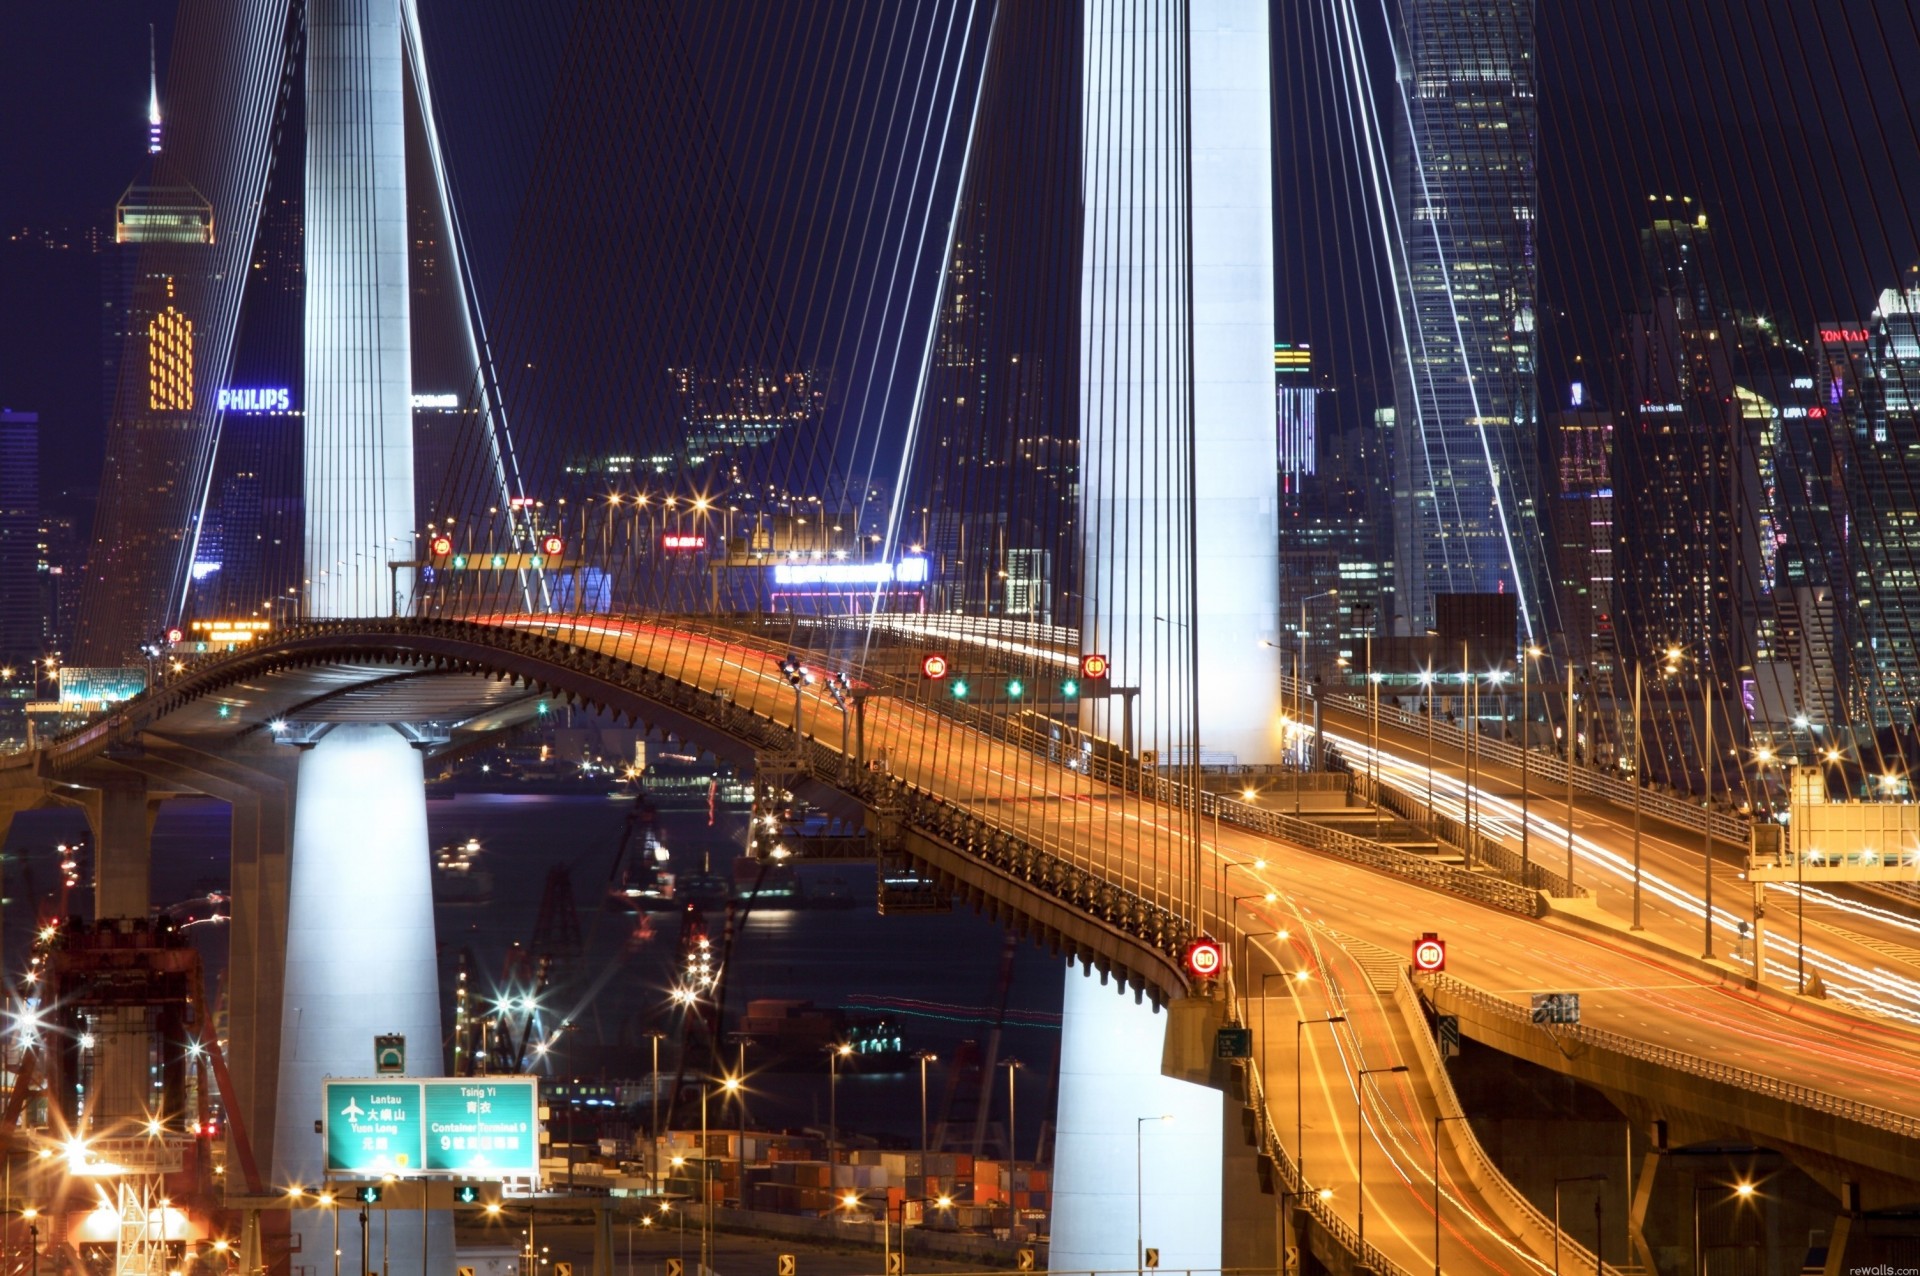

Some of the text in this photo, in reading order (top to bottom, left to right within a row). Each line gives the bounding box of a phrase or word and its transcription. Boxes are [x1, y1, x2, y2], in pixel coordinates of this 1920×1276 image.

[218, 388, 289, 410] PHILIPS
[1197, 952, 1213, 966] 80
[1422, 948, 1438, 962] 80
[460, 1087, 496, 1098] Tsing Yi
[370, 1095, 401, 1104] Lantau
[351, 1123, 398, 1135] Yuen Long
[431, 1122, 477, 1133] Container
[519, 1122, 527, 1132] 9
